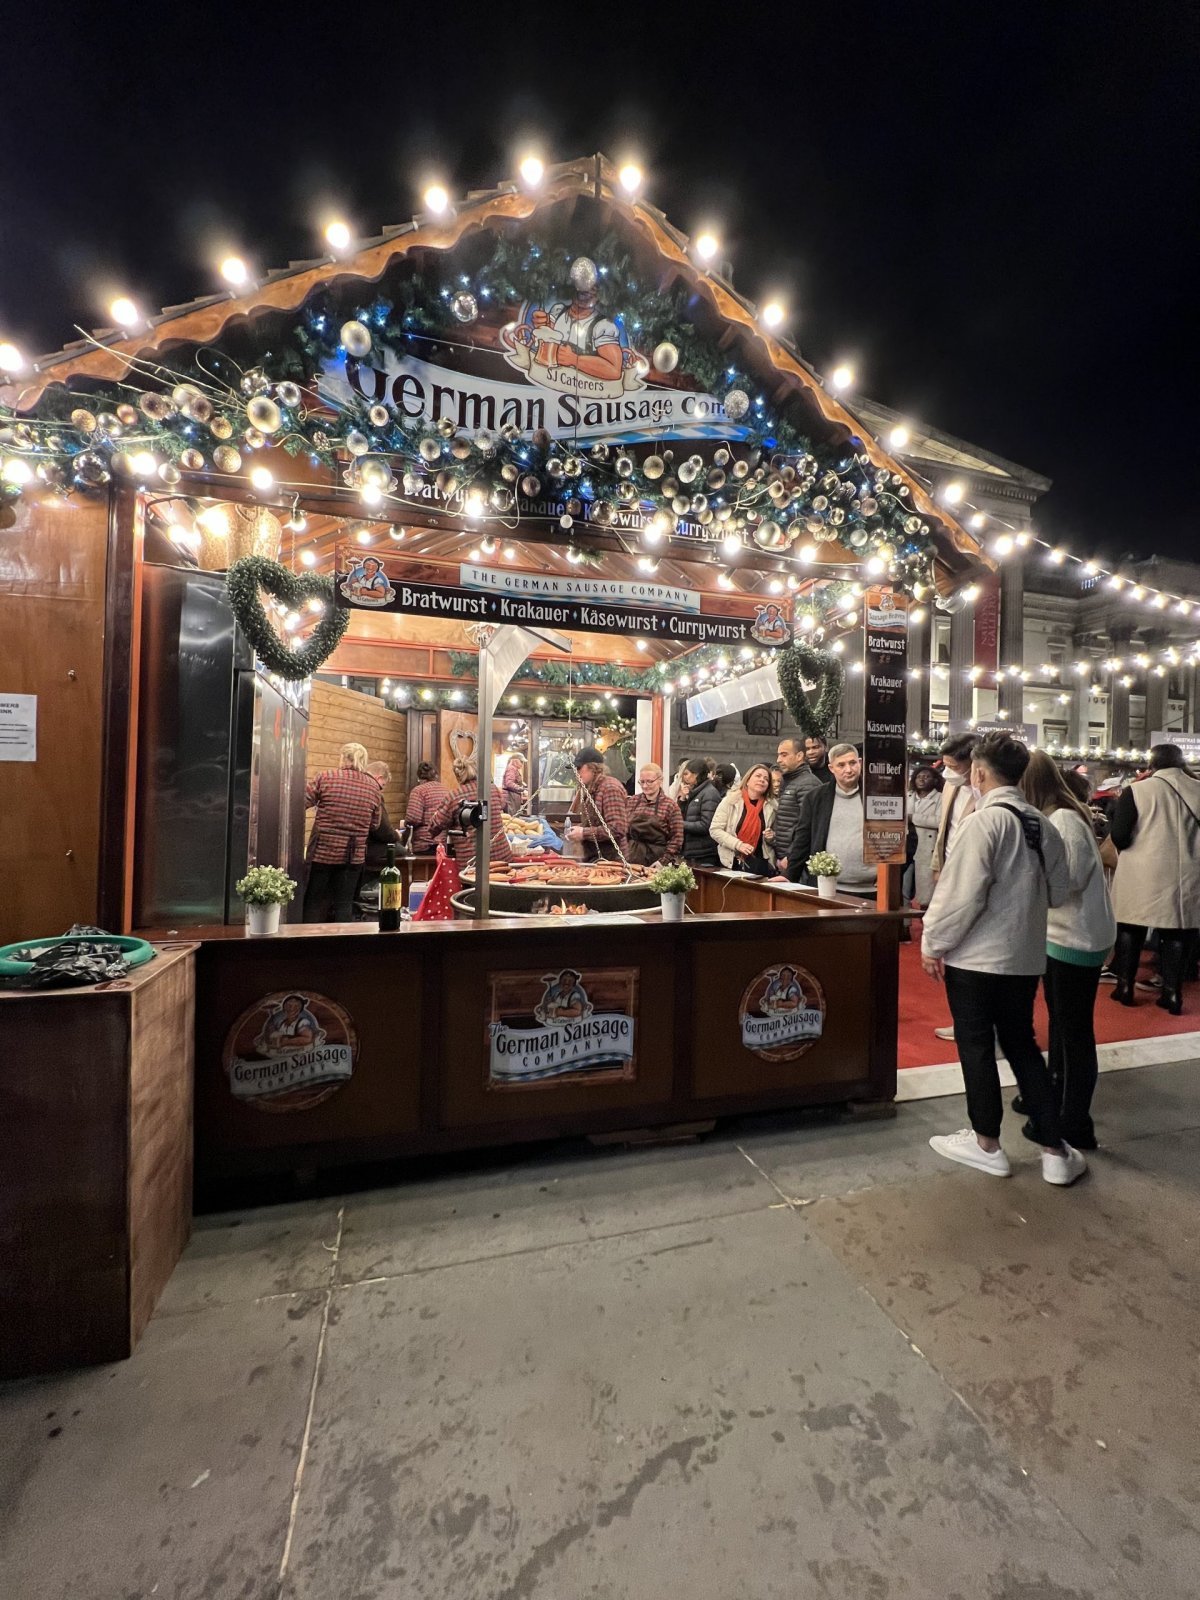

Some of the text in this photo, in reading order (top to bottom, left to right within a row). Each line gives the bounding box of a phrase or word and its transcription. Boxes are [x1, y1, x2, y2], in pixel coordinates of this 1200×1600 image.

[547, 367, 604, 392] SJ Caterers
[557, 393, 674, 428] Sausage
[472, 570, 688, 602] THE GERMAN SAUSAGE COMPANY
[402, 587, 747, 640] Bratwurst Krakauer Käsewurst Currywurst
[868, 635, 906, 650] Bratwurst
[870, 674, 903, 688] Krakauer
[867, 720, 905, 734] Käsewurst
[868, 762, 903, 775] Chilli Beef
[867, 831, 904, 841] Food Allergy?
[745, 1012, 820, 1033] German Sausage
[759, 1025, 805, 1041] COMPANY
[496, 1019, 629, 1054] German Sausage
[233, 1059, 289, 1081] German
[290, 1047, 348, 1069] Sausage
[522, 1038, 603, 1068] COMPANY
[257, 1063, 326, 1089] COMPANY
